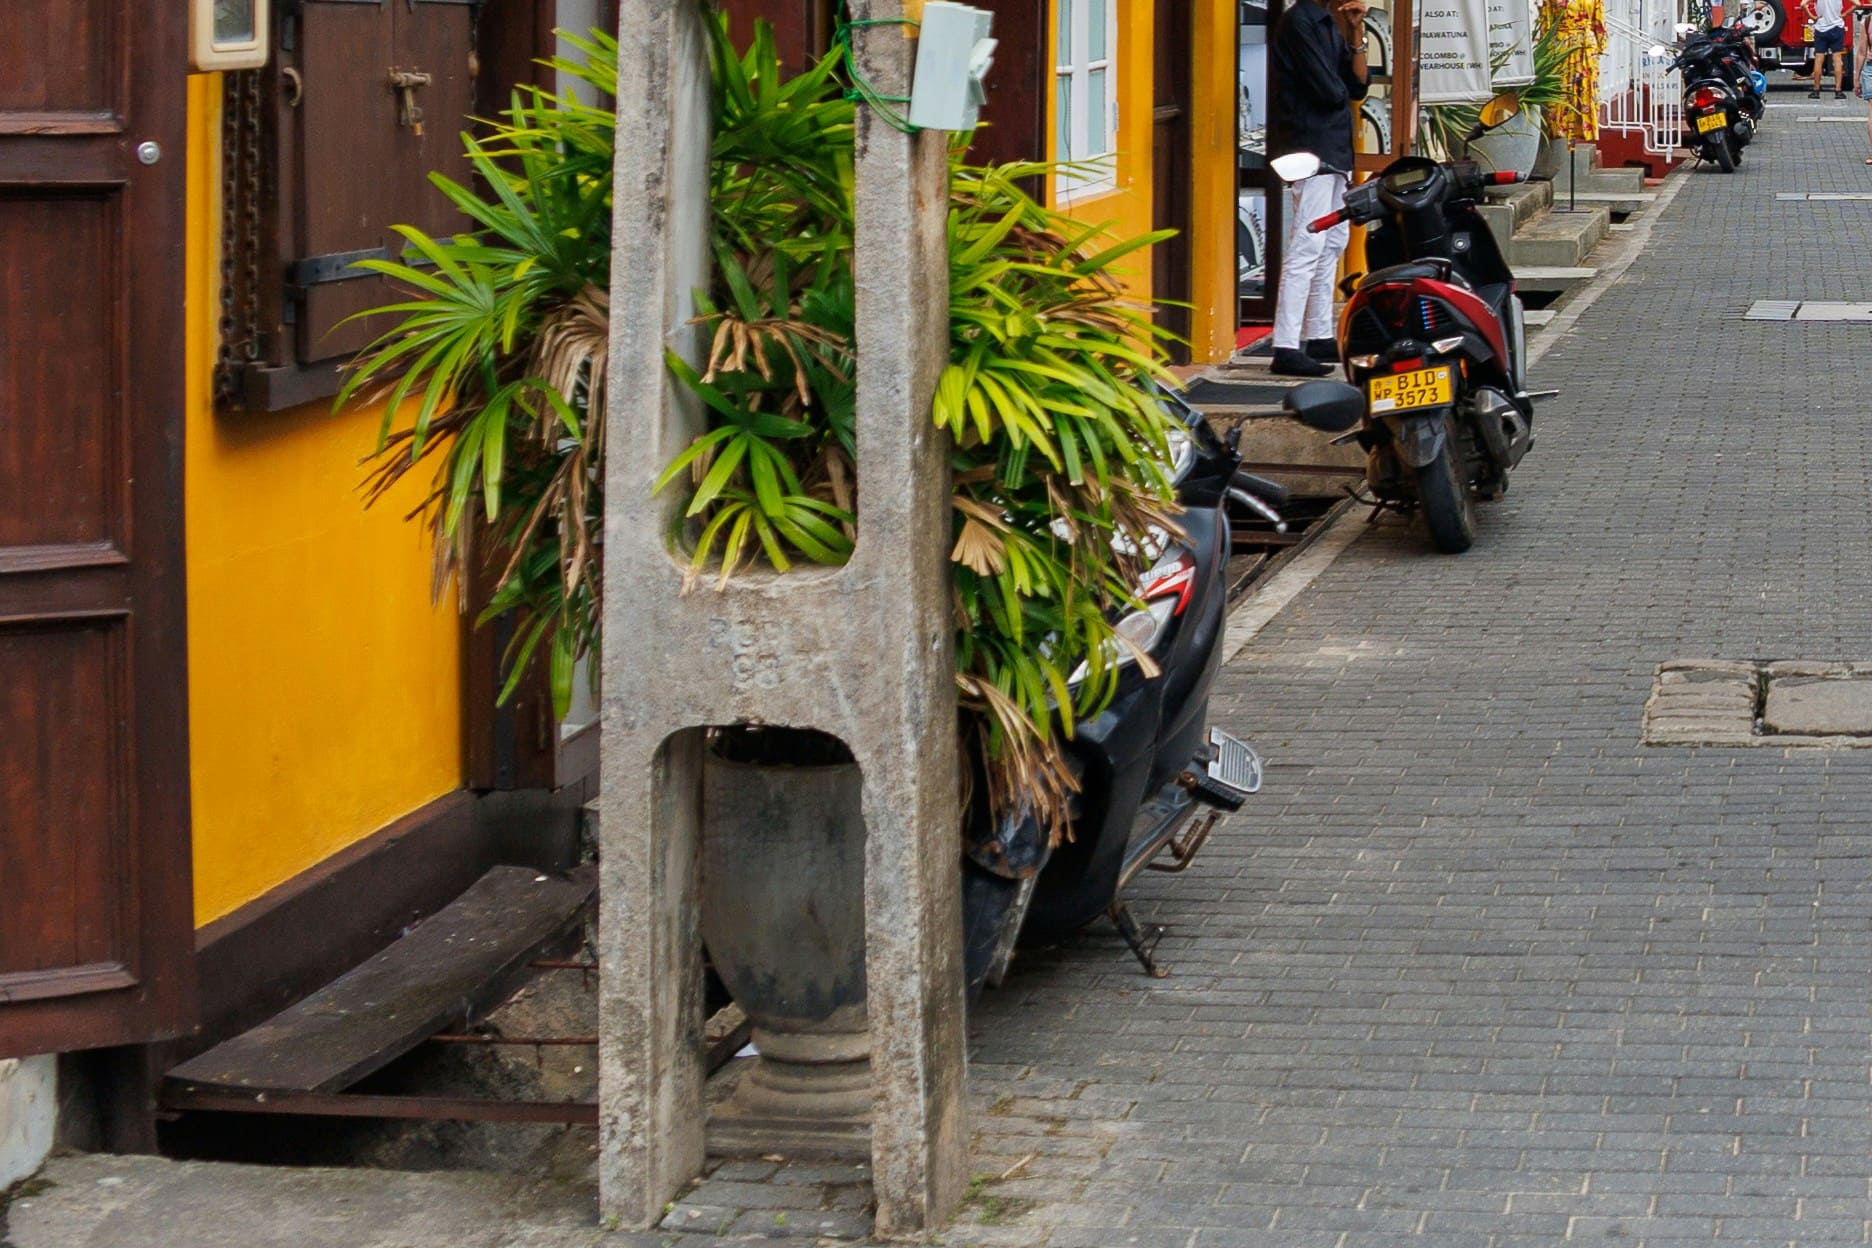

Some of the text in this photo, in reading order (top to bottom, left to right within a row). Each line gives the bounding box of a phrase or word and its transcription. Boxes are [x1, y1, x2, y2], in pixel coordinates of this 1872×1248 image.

[1424, 10, 1445, 18] ALSO
[1397, 370, 1436, 391] BID
[1394, 387, 1439, 408] 3573
